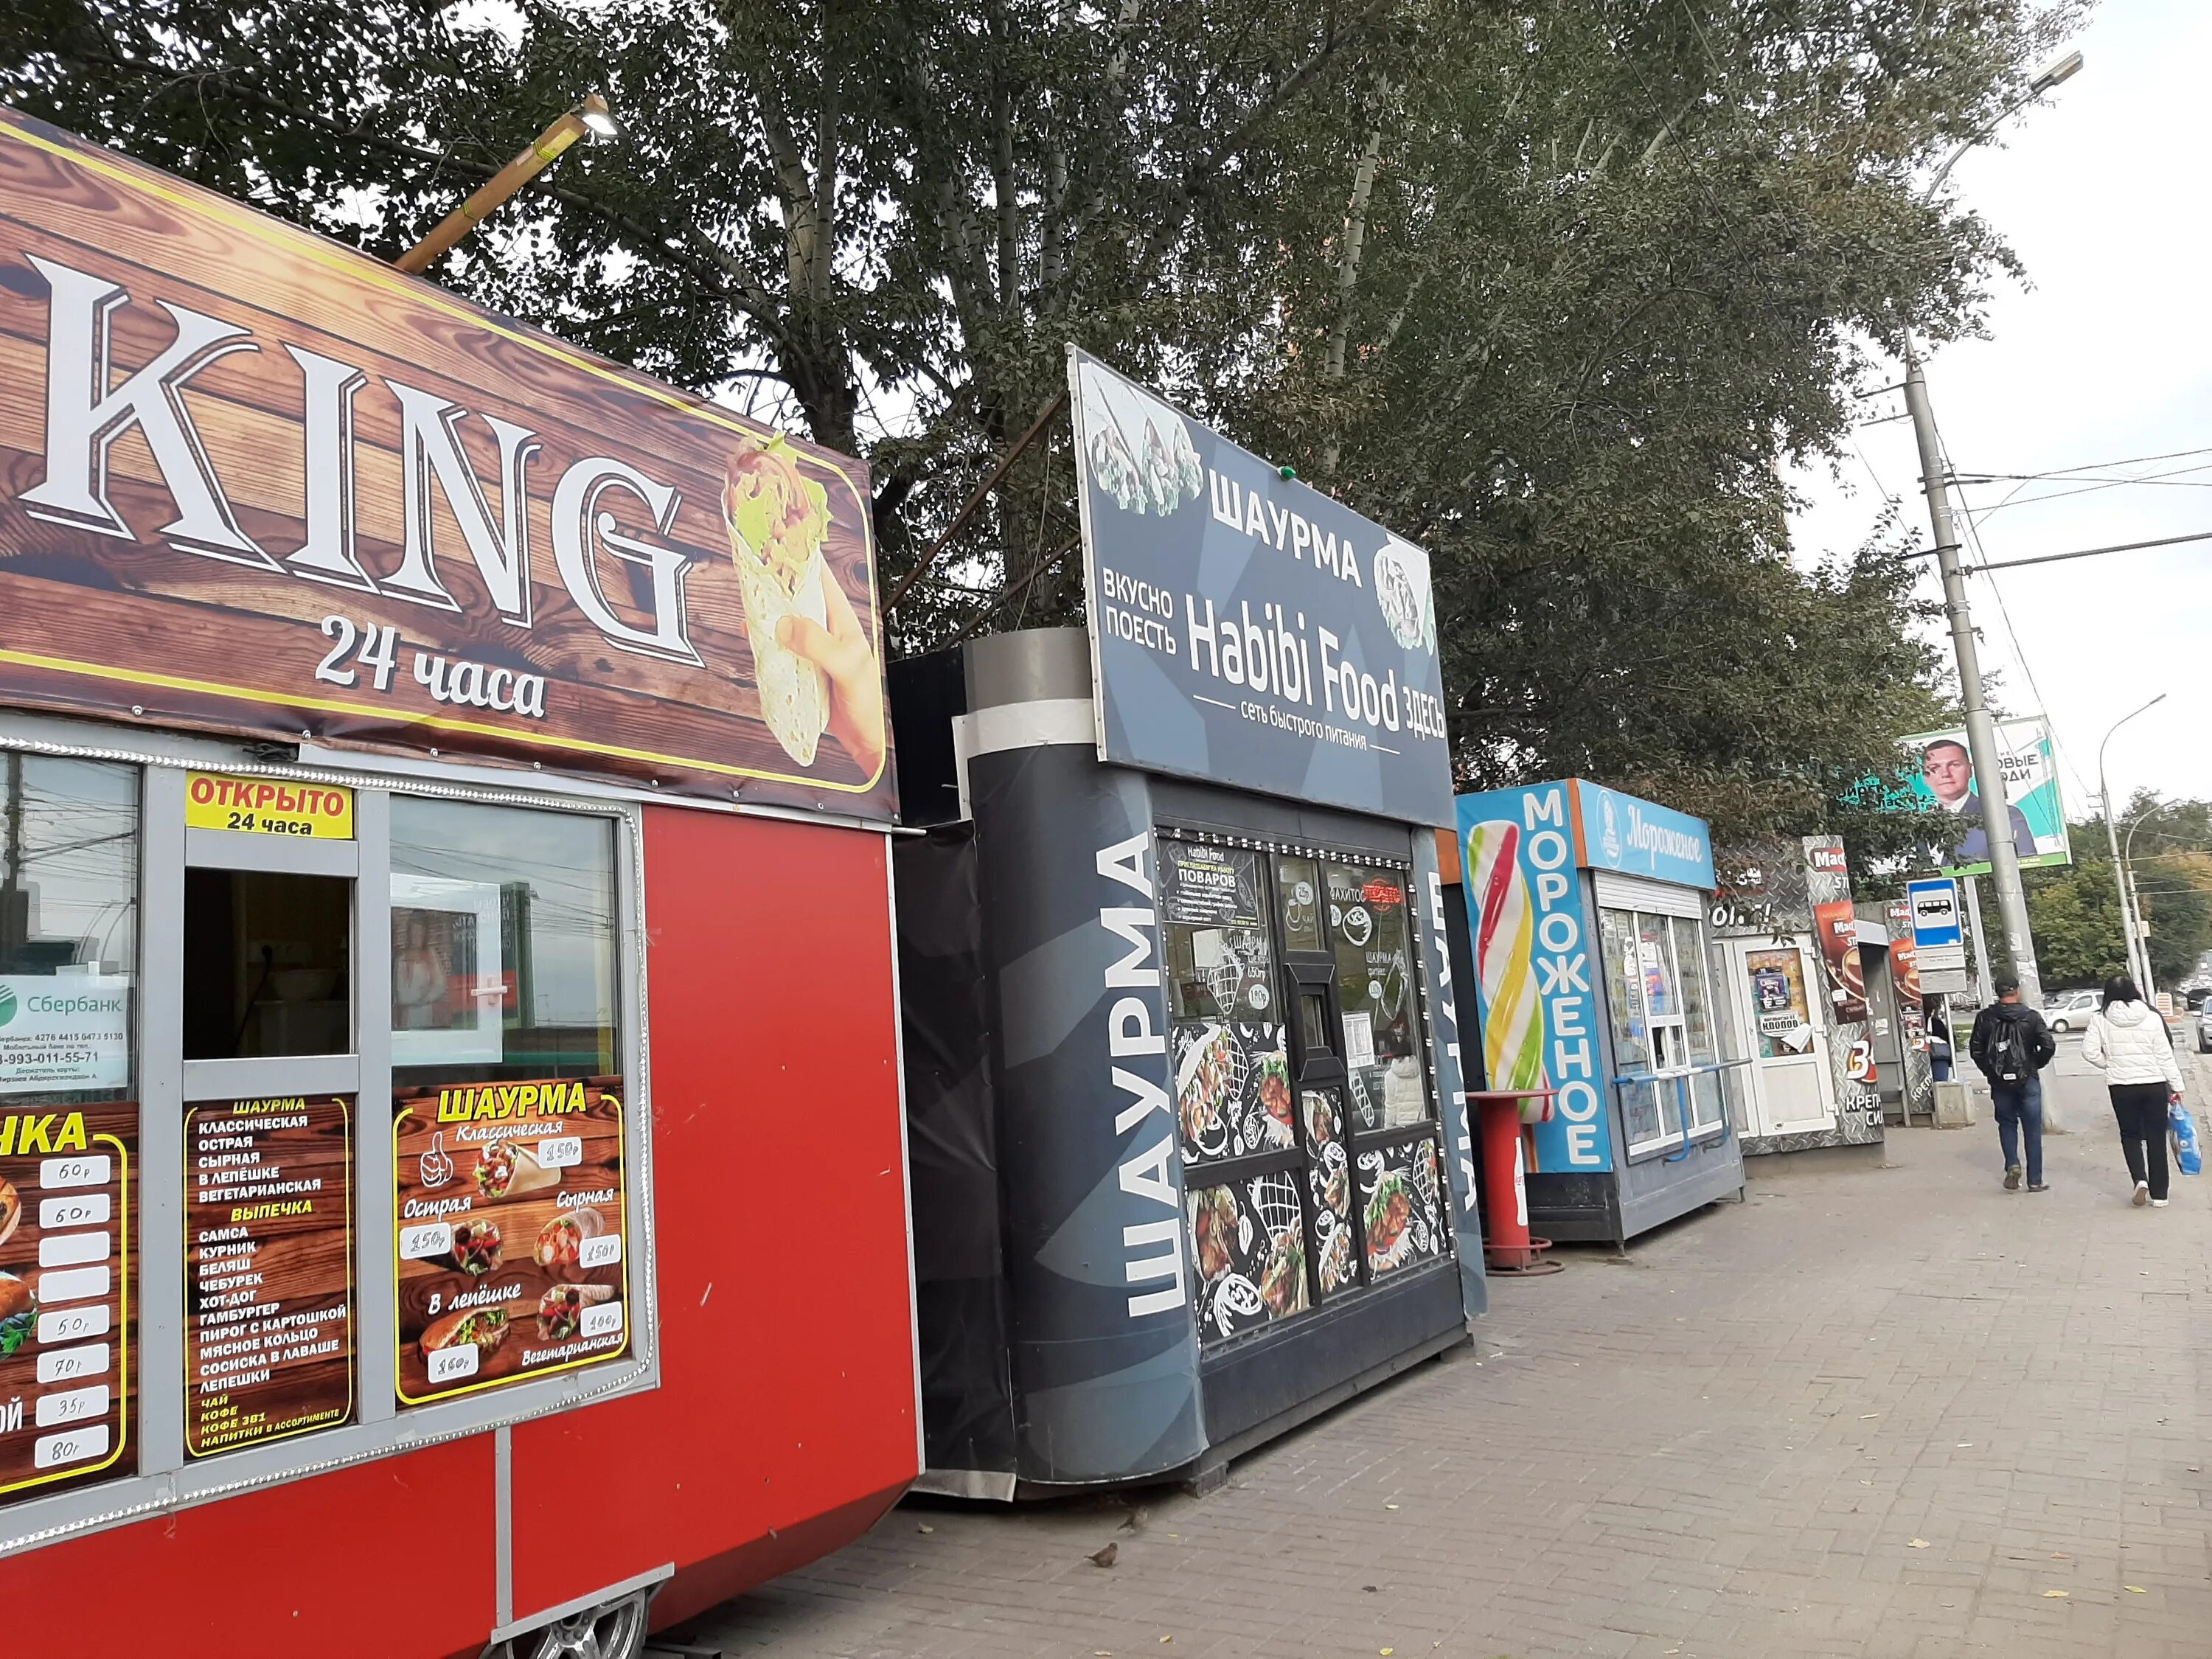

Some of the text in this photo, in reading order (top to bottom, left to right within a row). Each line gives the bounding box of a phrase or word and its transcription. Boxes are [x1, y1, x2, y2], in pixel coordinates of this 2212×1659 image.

[18, 249, 706, 669] KING
[1208, 468, 1363, 588] ШАУРМА
[1102, 567, 1174, 620] ВКУСНО
[1106, 605, 1177, 656] ПОЕСТЬ
[315, 614, 547, 719] 24 часа
[1185, 594, 1401, 733] Habibi Food
[1240, 700, 1368, 751] сеть быстрого питания
[1402, 686, 1446, 740] ЗДЕСЬ
[190, 777, 344, 817] ОТКРЫТО
[226, 812, 313, 835] 24 часа
[1627, 804, 1702, 870] Мороженое
[1178, 869, 1237, 888] ПОВАРОВ
[1522, 788, 1600, 1166] МОРОЖЕНОЕ
[27, 995, 123, 1016] Сбербанк
[1096, 830, 1186, 1318] ШАУРМА
[233, 1098, 306, 1114] ШАУРМА
[437, 1082, 587, 1124] ШАУРМА
[198, 1116, 308, 1135] КЛАССИЧЕСКАЯ
[455, 1121, 563, 1142] Классическая
[198, 1136, 253, 1152] ОСТРАЯ
[59, 1164, 91, 1180] 60р
[198, 1152, 260, 1169] СЫРНАЯ
[199, 1166, 280, 1186] В ЛЕПЁШКЕ
[199, 1178, 321, 1203] ВЕГЕТАРИАНСКАЯ
[556, 1188, 615, 1213] Сырная
[55, 1206, 91, 1223] 60р
[230, 1200, 313, 1222] ВЫПЕЧКА
[404, 1196, 472, 1222] Острая
[199, 1226, 248, 1243] САМСА
[199, 1241, 257, 1259] КУРНИК
[199, 1259, 251, 1276] БЕЛЯШ
[200, 1273, 263, 1293] ЧЕБУРЕК
[200, 1290, 257, 1310] ХОТ-ДОГ
[428, 1282, 522, 1315] В лепёшке
[200, 1302, 280, 1326] ГАМБУРГЕР
[200, 1304, 347, 1343] ПИРОГ С КАРТОШКОЙ
[200, 1327, 319, 1360] МЯСНОЕ КОЛЬЦО
[521, 1332, 624, 1366] Вегетарианская
[200, 1339, 339, 1376] СОСИСКА В ЛАВАШЕ
[200, 1369, 271, 1394] ЛЕПЕШКИ
[201, 1394, 229, 1408] ЧАЙ
[201, 1405, 239, 1422] КОФЕ
[201, 1418, 237, 1436] КОФЕ
[201, 1426, 262, 1448] НАПИТКИ
[274, 1409, 340, 1432] АССОРТИМЕНТЕ
